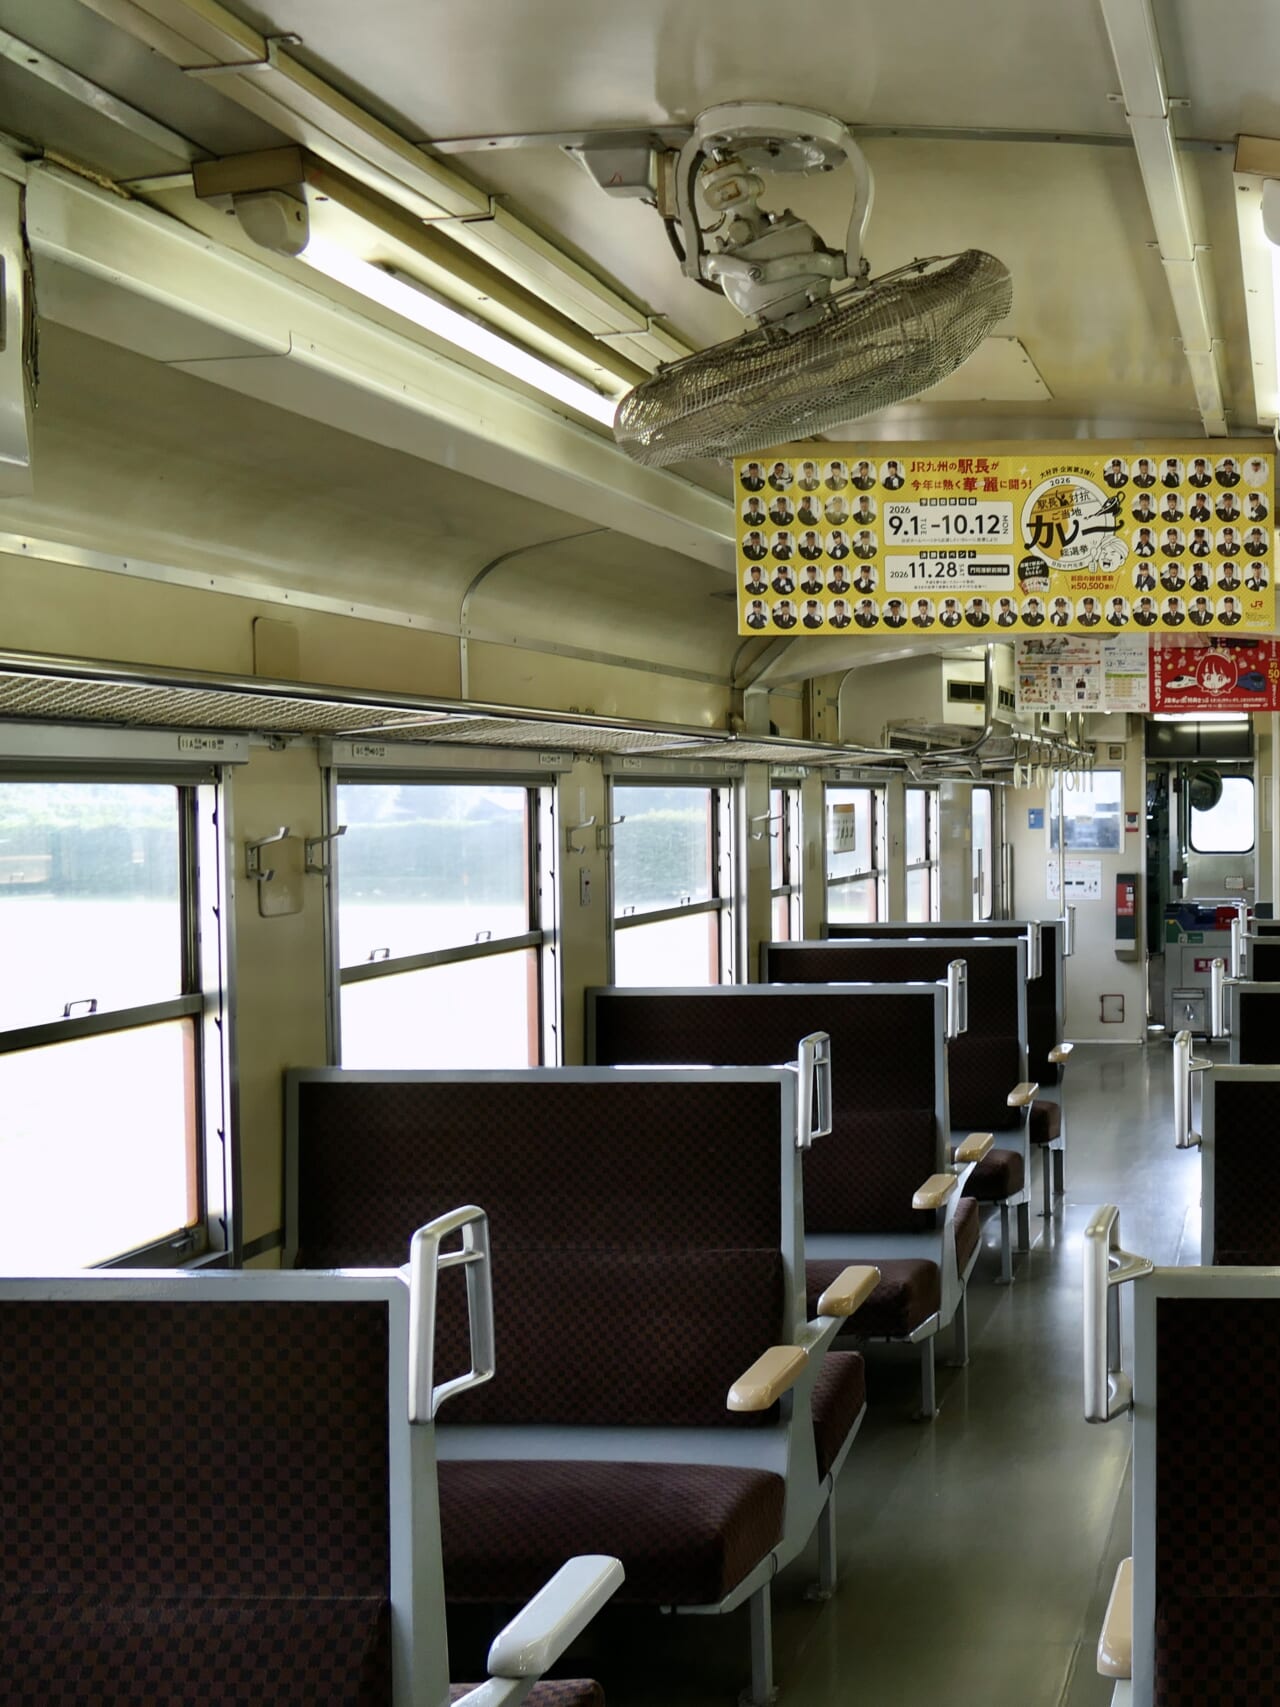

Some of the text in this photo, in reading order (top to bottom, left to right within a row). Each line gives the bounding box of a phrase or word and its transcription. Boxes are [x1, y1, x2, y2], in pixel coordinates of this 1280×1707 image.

[910, 458, 999, 474] JR九州の駅長が
[911, 477, 1032, 493] 今年は熱く華麗に闘う!
[1050, 477, 1071, 486] 2026
[1037, 490, 1091, 510] 駅長 対抗
[889, 505, 911, 514] 2026
[1052, 507, 1083, 520] ご当地
[889, 515, 918, 536] 9.1
[1024, 514, 1124, 550] カレー
[909, 562, 958, 578] 11.28
[1250, 600, 1264, 608] JR
